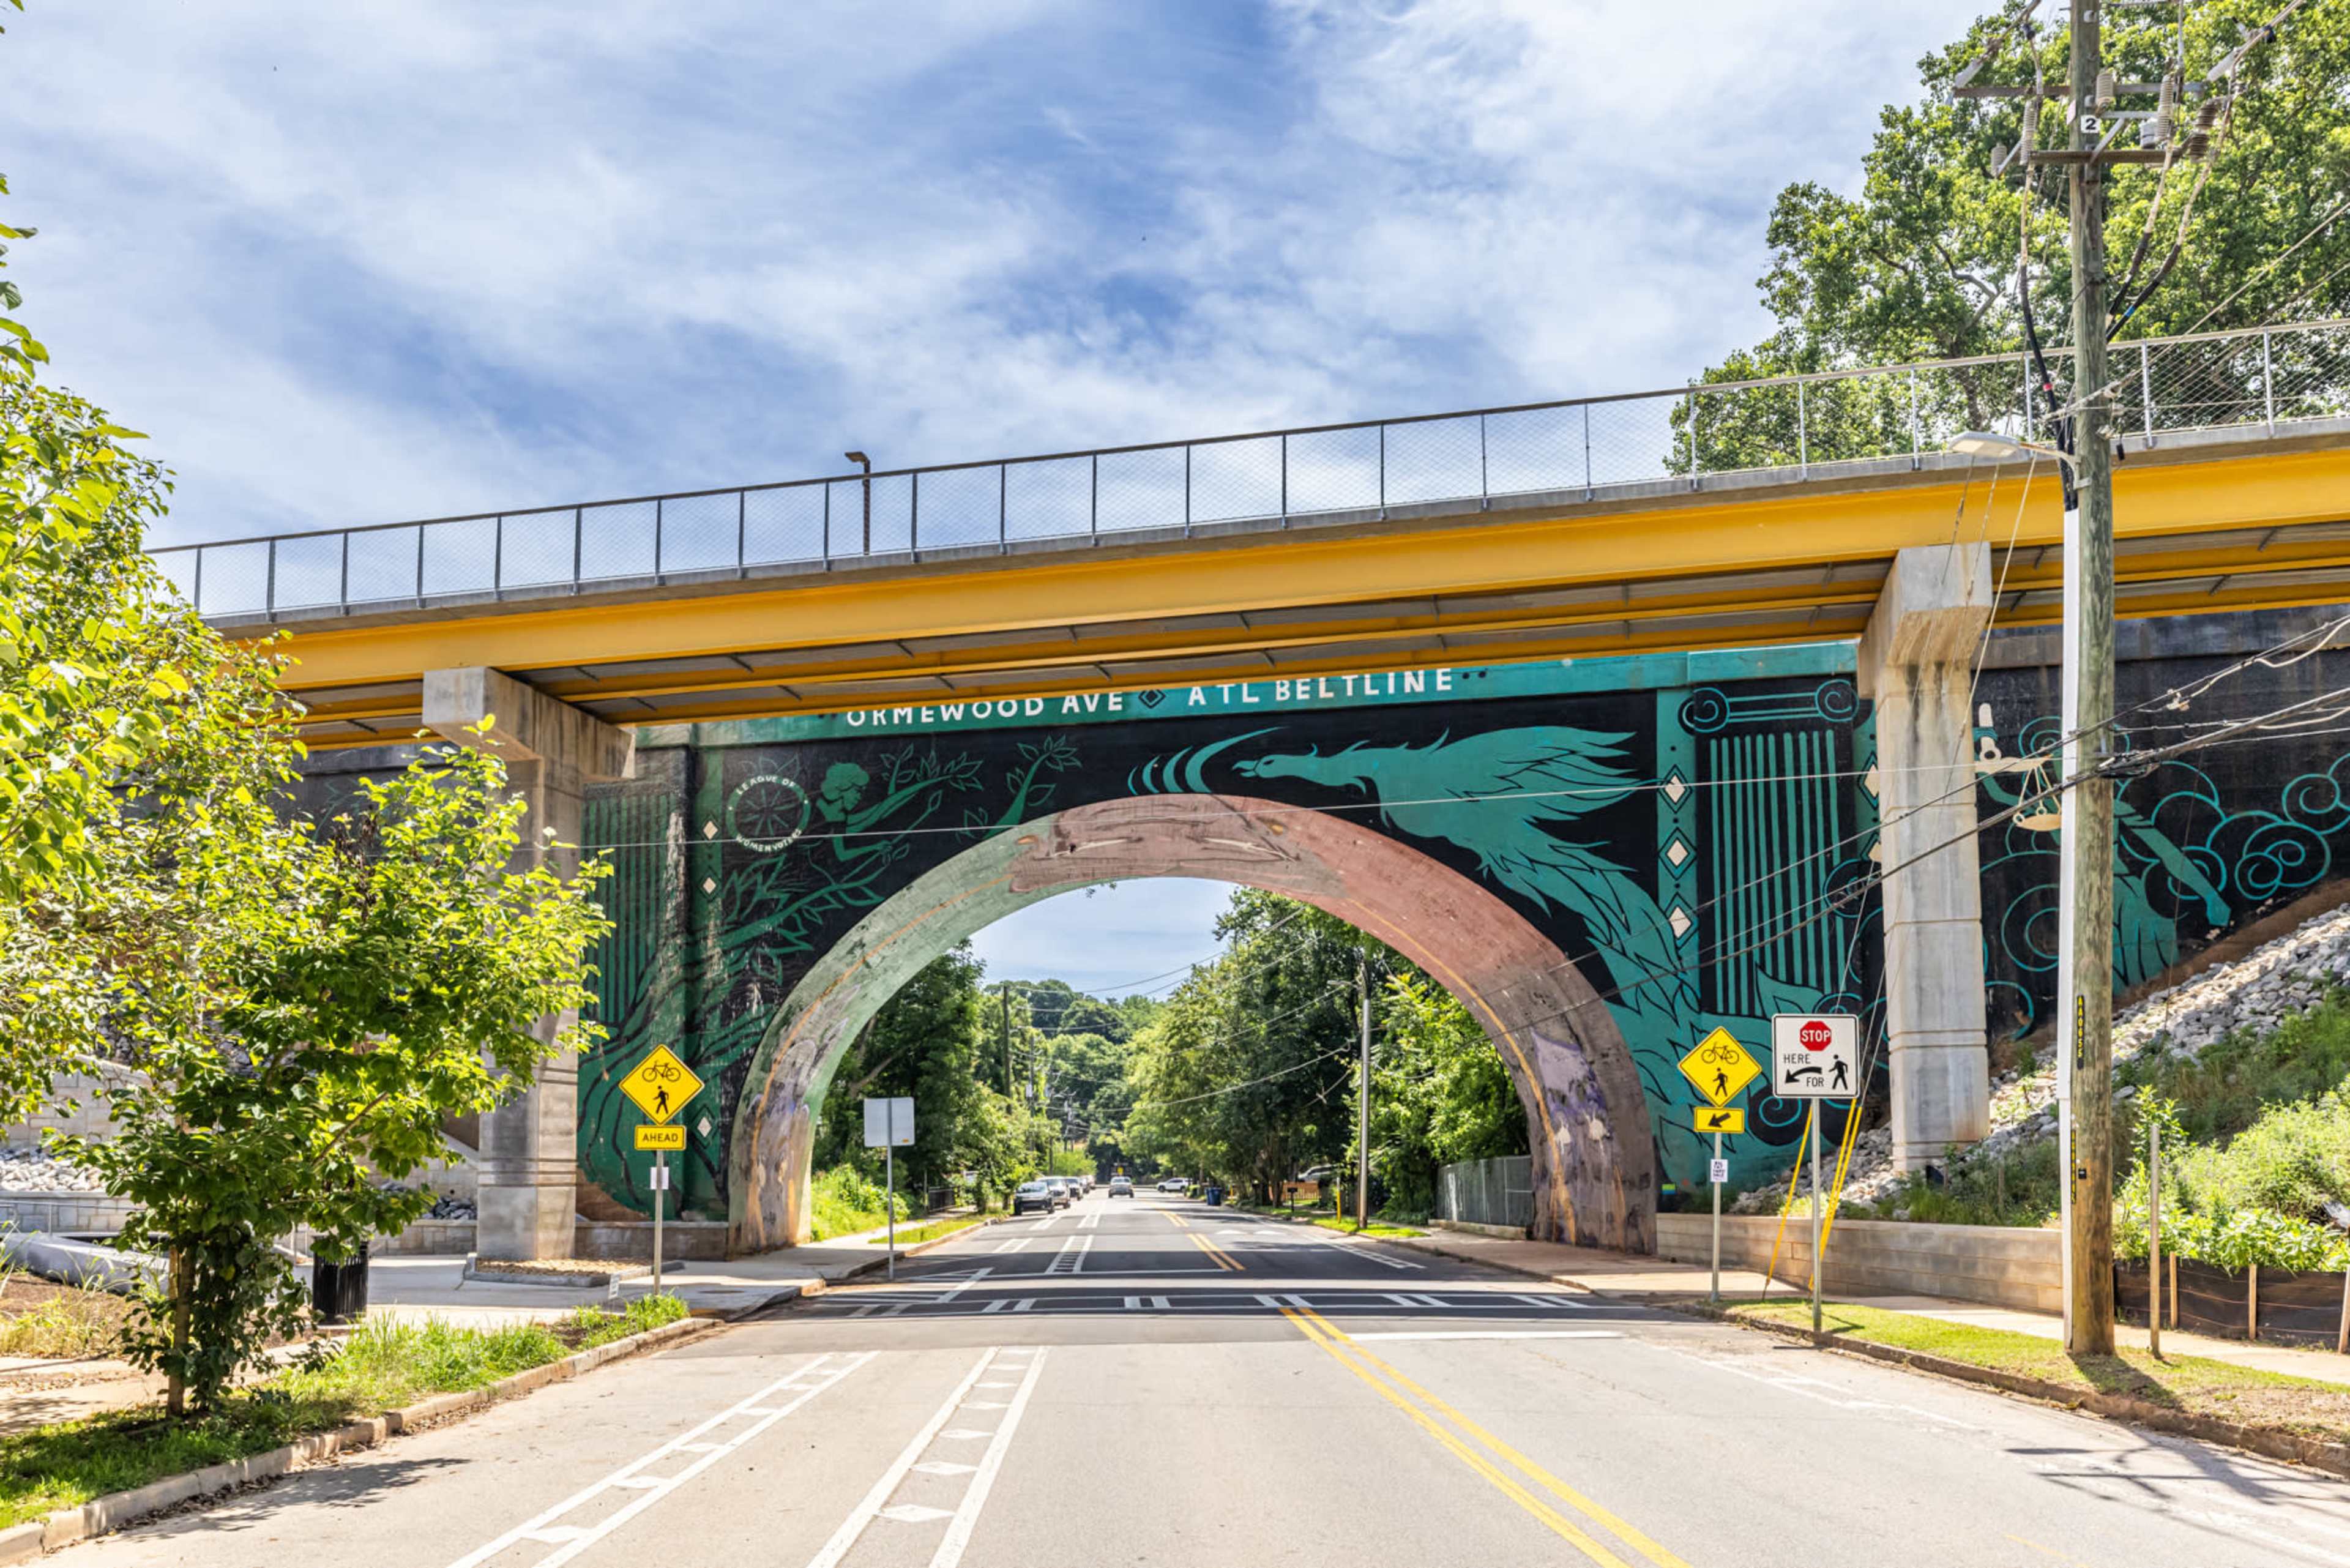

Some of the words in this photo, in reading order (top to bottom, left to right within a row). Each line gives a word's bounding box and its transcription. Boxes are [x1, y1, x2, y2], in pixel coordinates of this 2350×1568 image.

[2086, 118, 2096, 130] 2
[847, 697, 1044, 726] ORMEWOOD
[1062, 691, 1122, 714] AVE
[1188, 682, 1260, 705] ATL
[1275, 668, 1452, 701] BELTLINE
[736, 775, 778, 795] LEAGUE
[782, 778, 796, 787] OF
[736, 833, 772, 853] WOMEN
[1801, 1029, 1831, 1043] STOP
[1783, 1053, 1811, 1064] HERE
[1806, 1077, 1825, 1088] FOR
[643, 1132, 679, 1143] AHEAD
